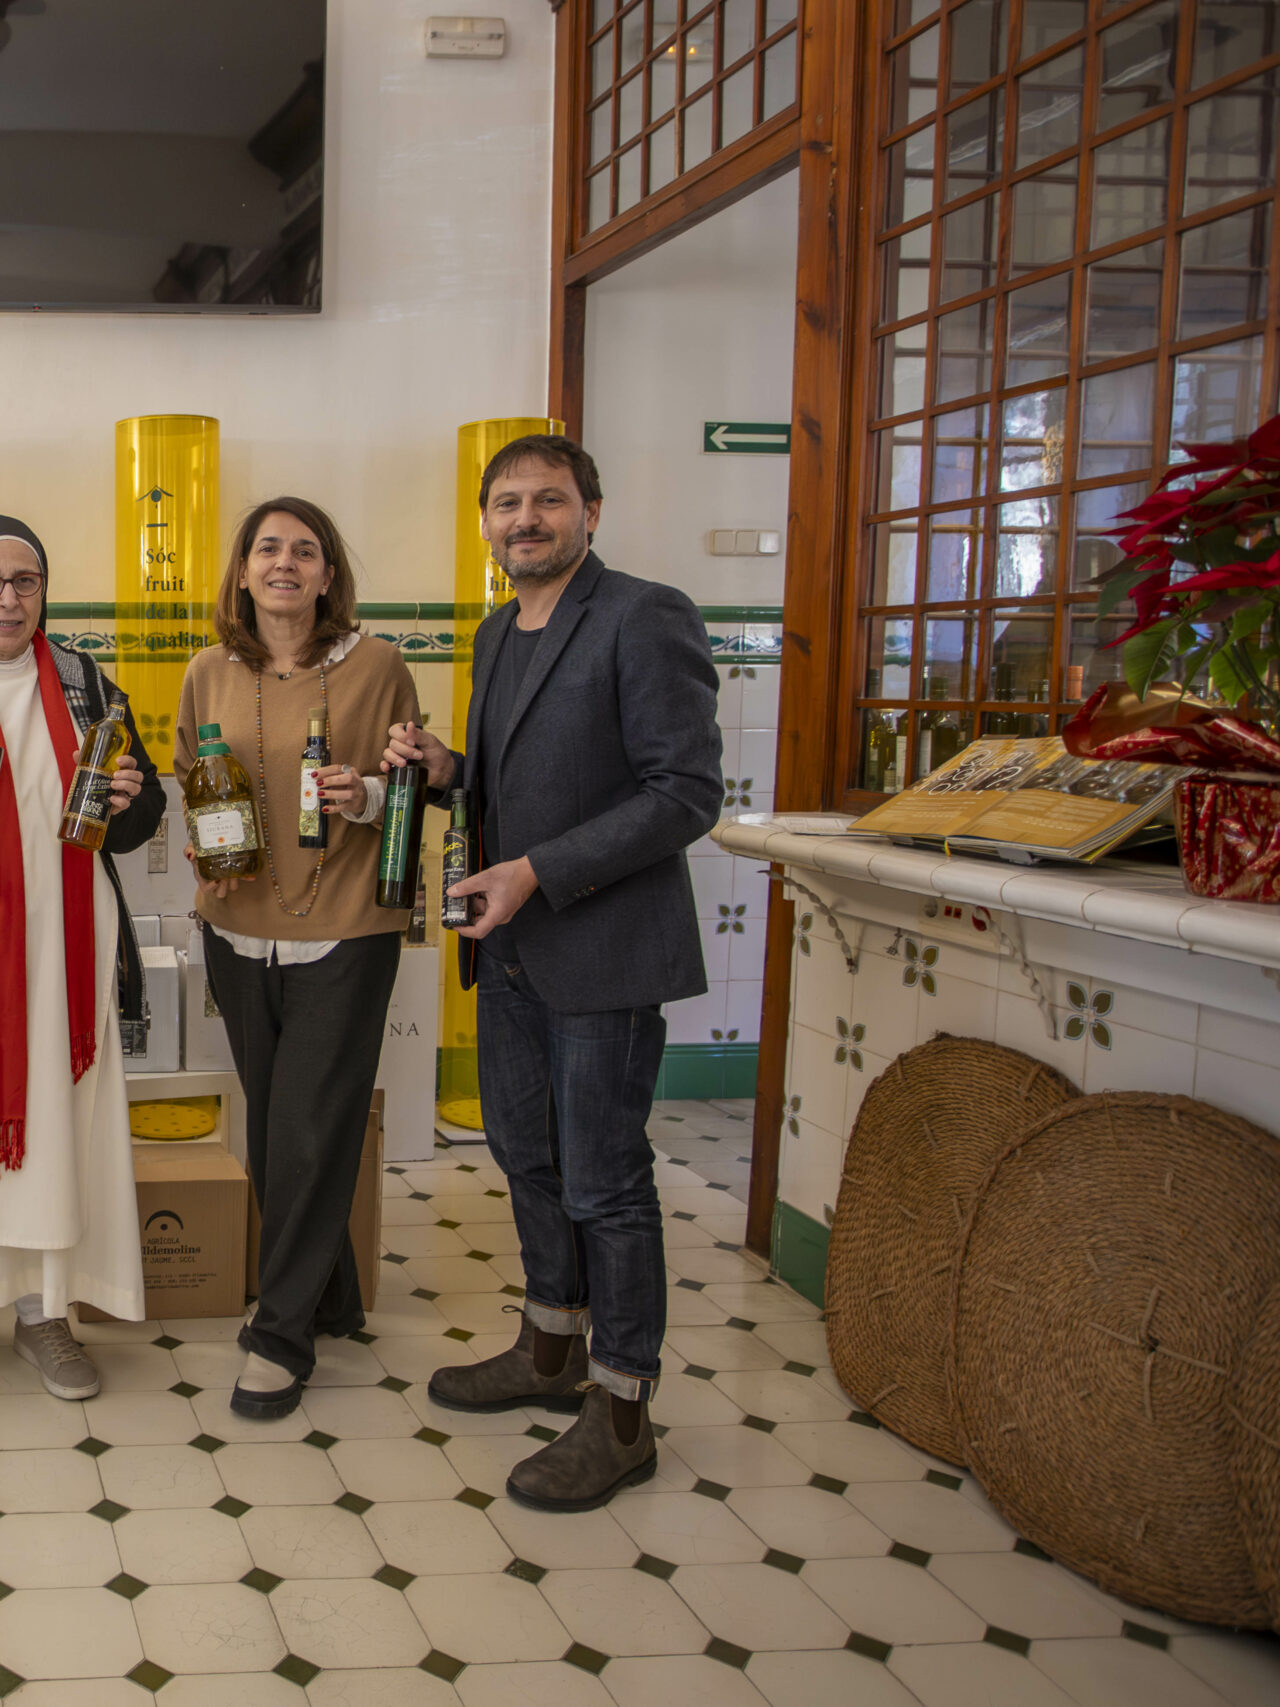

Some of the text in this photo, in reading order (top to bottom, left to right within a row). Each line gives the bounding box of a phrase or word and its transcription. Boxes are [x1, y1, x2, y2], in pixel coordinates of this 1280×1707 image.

[146, 547, 176, 564] Sóc
[146, 575, 184, 591] fruit
[146, 603, 188, 619] de la
[141, 1244, 201, 1255] lldemolins
